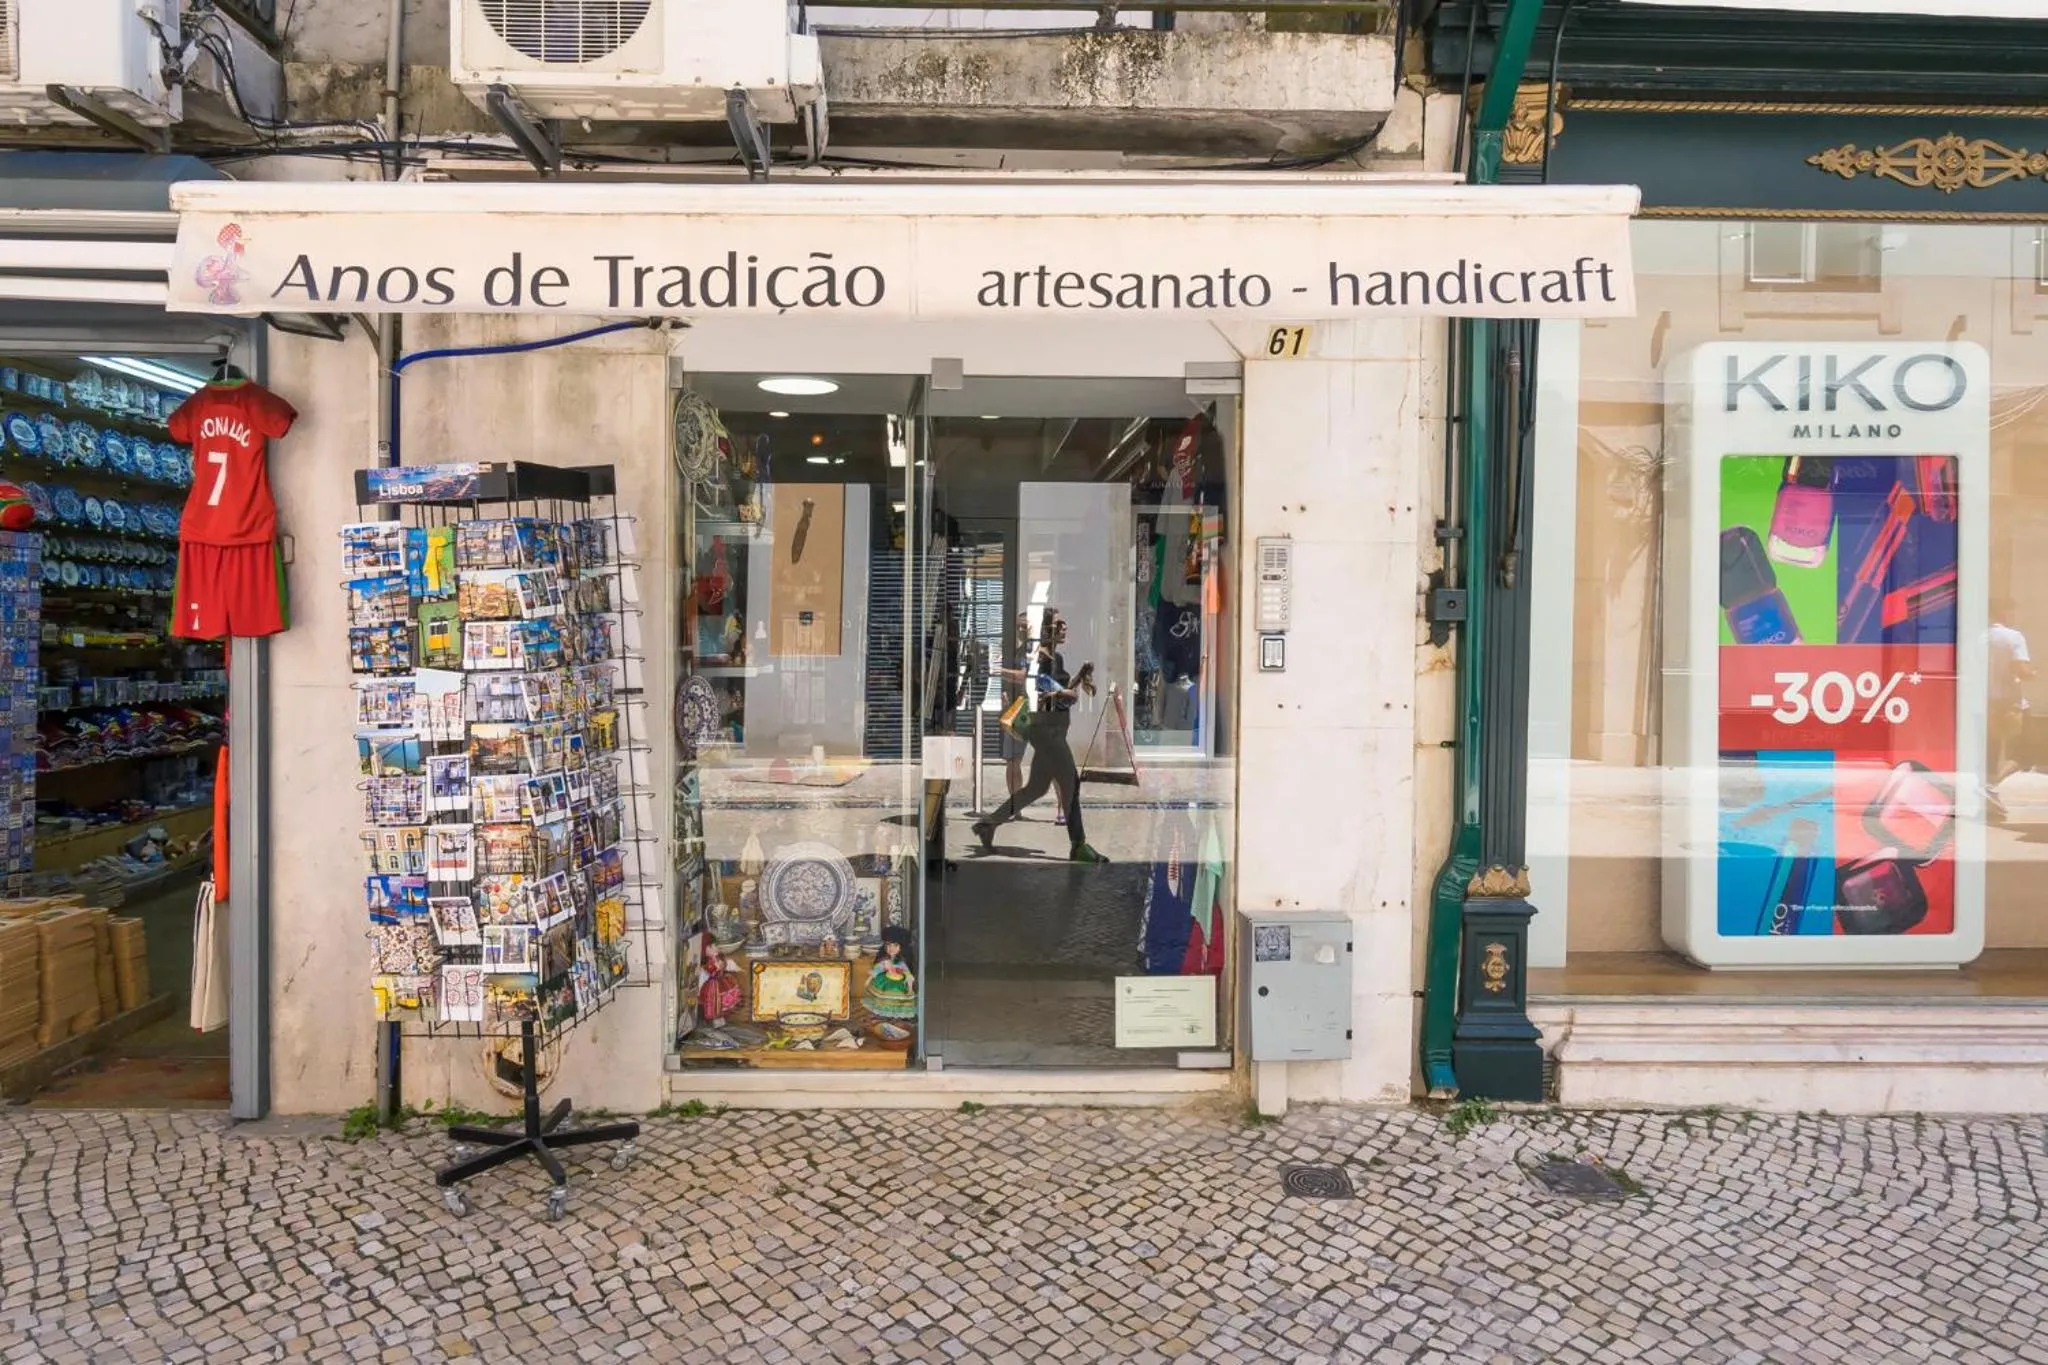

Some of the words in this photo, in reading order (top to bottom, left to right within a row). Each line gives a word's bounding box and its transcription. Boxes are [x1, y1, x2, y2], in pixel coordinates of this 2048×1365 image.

[271, 253, 455, 306] Anos
[484, 251, 570, 308] de
[593, 251, 886, 315] Tradição
[977, 264, 1272, 309] artesanato
[1329, 257, 1617, 306] handicraft
[1269, 327, 1305, 356] 61
[1724, 353, 1968, 413] KIKO
[1793, 424, 1903, 438] MILANO
[207, 451, 229, 506] 7
[378, 483, 424, 498] Lisboa
